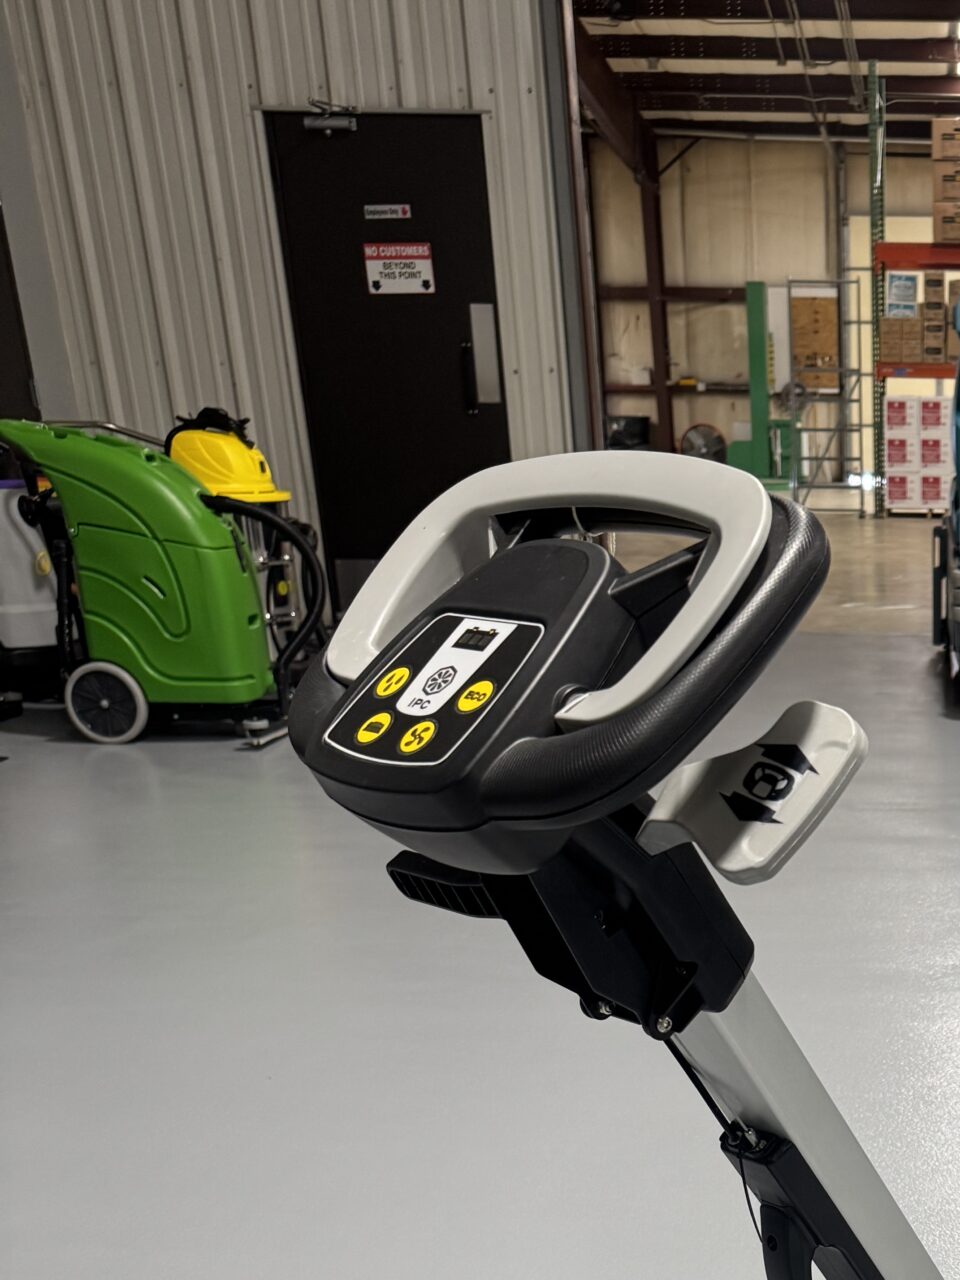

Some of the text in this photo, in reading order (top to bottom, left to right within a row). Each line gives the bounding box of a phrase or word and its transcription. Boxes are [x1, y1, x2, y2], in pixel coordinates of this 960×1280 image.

[364, 245, 430, 256] NO CUSTOMERS
[382, 261, 416, 270] BEYOND
[379, 270, 422, 279] THIS POINT
[464, 691, 487, 702] ECO
[407, 697, 431, 710] IPC
